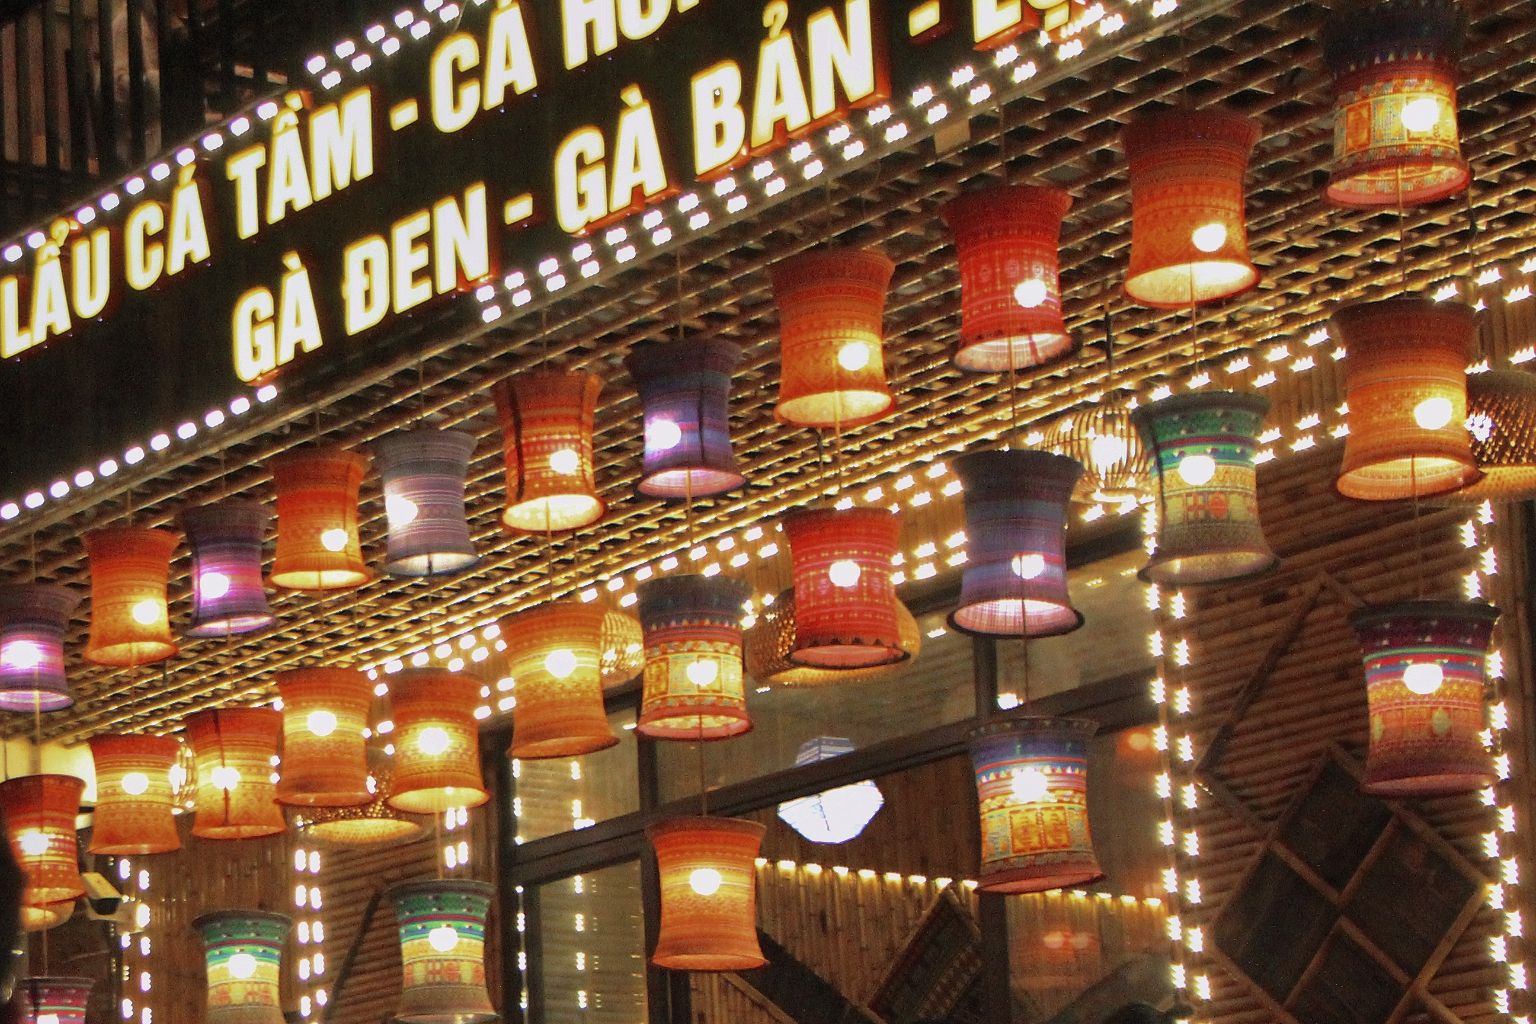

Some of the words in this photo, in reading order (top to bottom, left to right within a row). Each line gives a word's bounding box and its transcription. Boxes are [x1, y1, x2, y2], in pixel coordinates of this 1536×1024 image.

[0, 217, 110, 359] LẨU
[125, 163, 210, 291] CÁ
[227, 86, 373, 240] TẦM
[232, 250, 323, 382] GÀ
[343, 181, 489, 335] ĐEN
[554, 83, 667, 233] GÀ
[691, 0, 874, 175] BẢN
